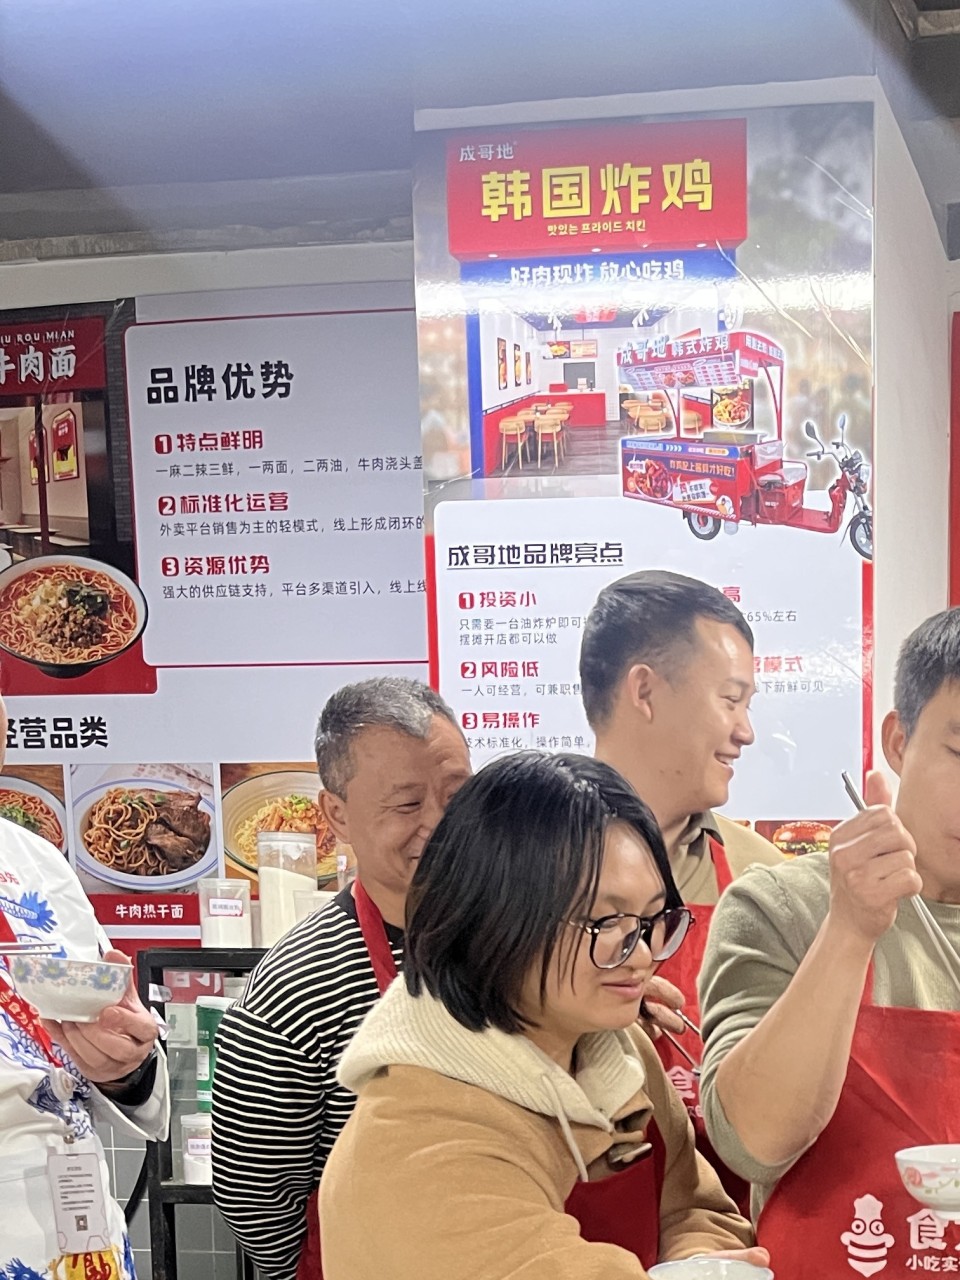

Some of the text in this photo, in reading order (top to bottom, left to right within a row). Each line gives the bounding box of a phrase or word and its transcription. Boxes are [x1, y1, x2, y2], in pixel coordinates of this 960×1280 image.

[459, 143, 514, 162] 成哥地
[481, 159, 713, 221] 韩国炸鸡
[547, 219, 646, 236] 맛있는 프라이드 치킨
[510, 259, 684, 288] 好肉现炸 放心吃鸡
[17, 333, 40, 342] ROU
[46, 330, 75, 340] MIAN
[147, 361, 294, 404] 品牌优势
[447, 542, 624, 566] 成哥地品牌亮点
[459, 616, 586, 631] 只需要一台油炸炉即可
[742, 611, 797, 621] 65%左右
[459, 633, 558, 646] 摆摊开店都可以做
[755, 681, 824, 693] 下新鲜可见
[115, 903, 184, 919] 牛肉热干面
